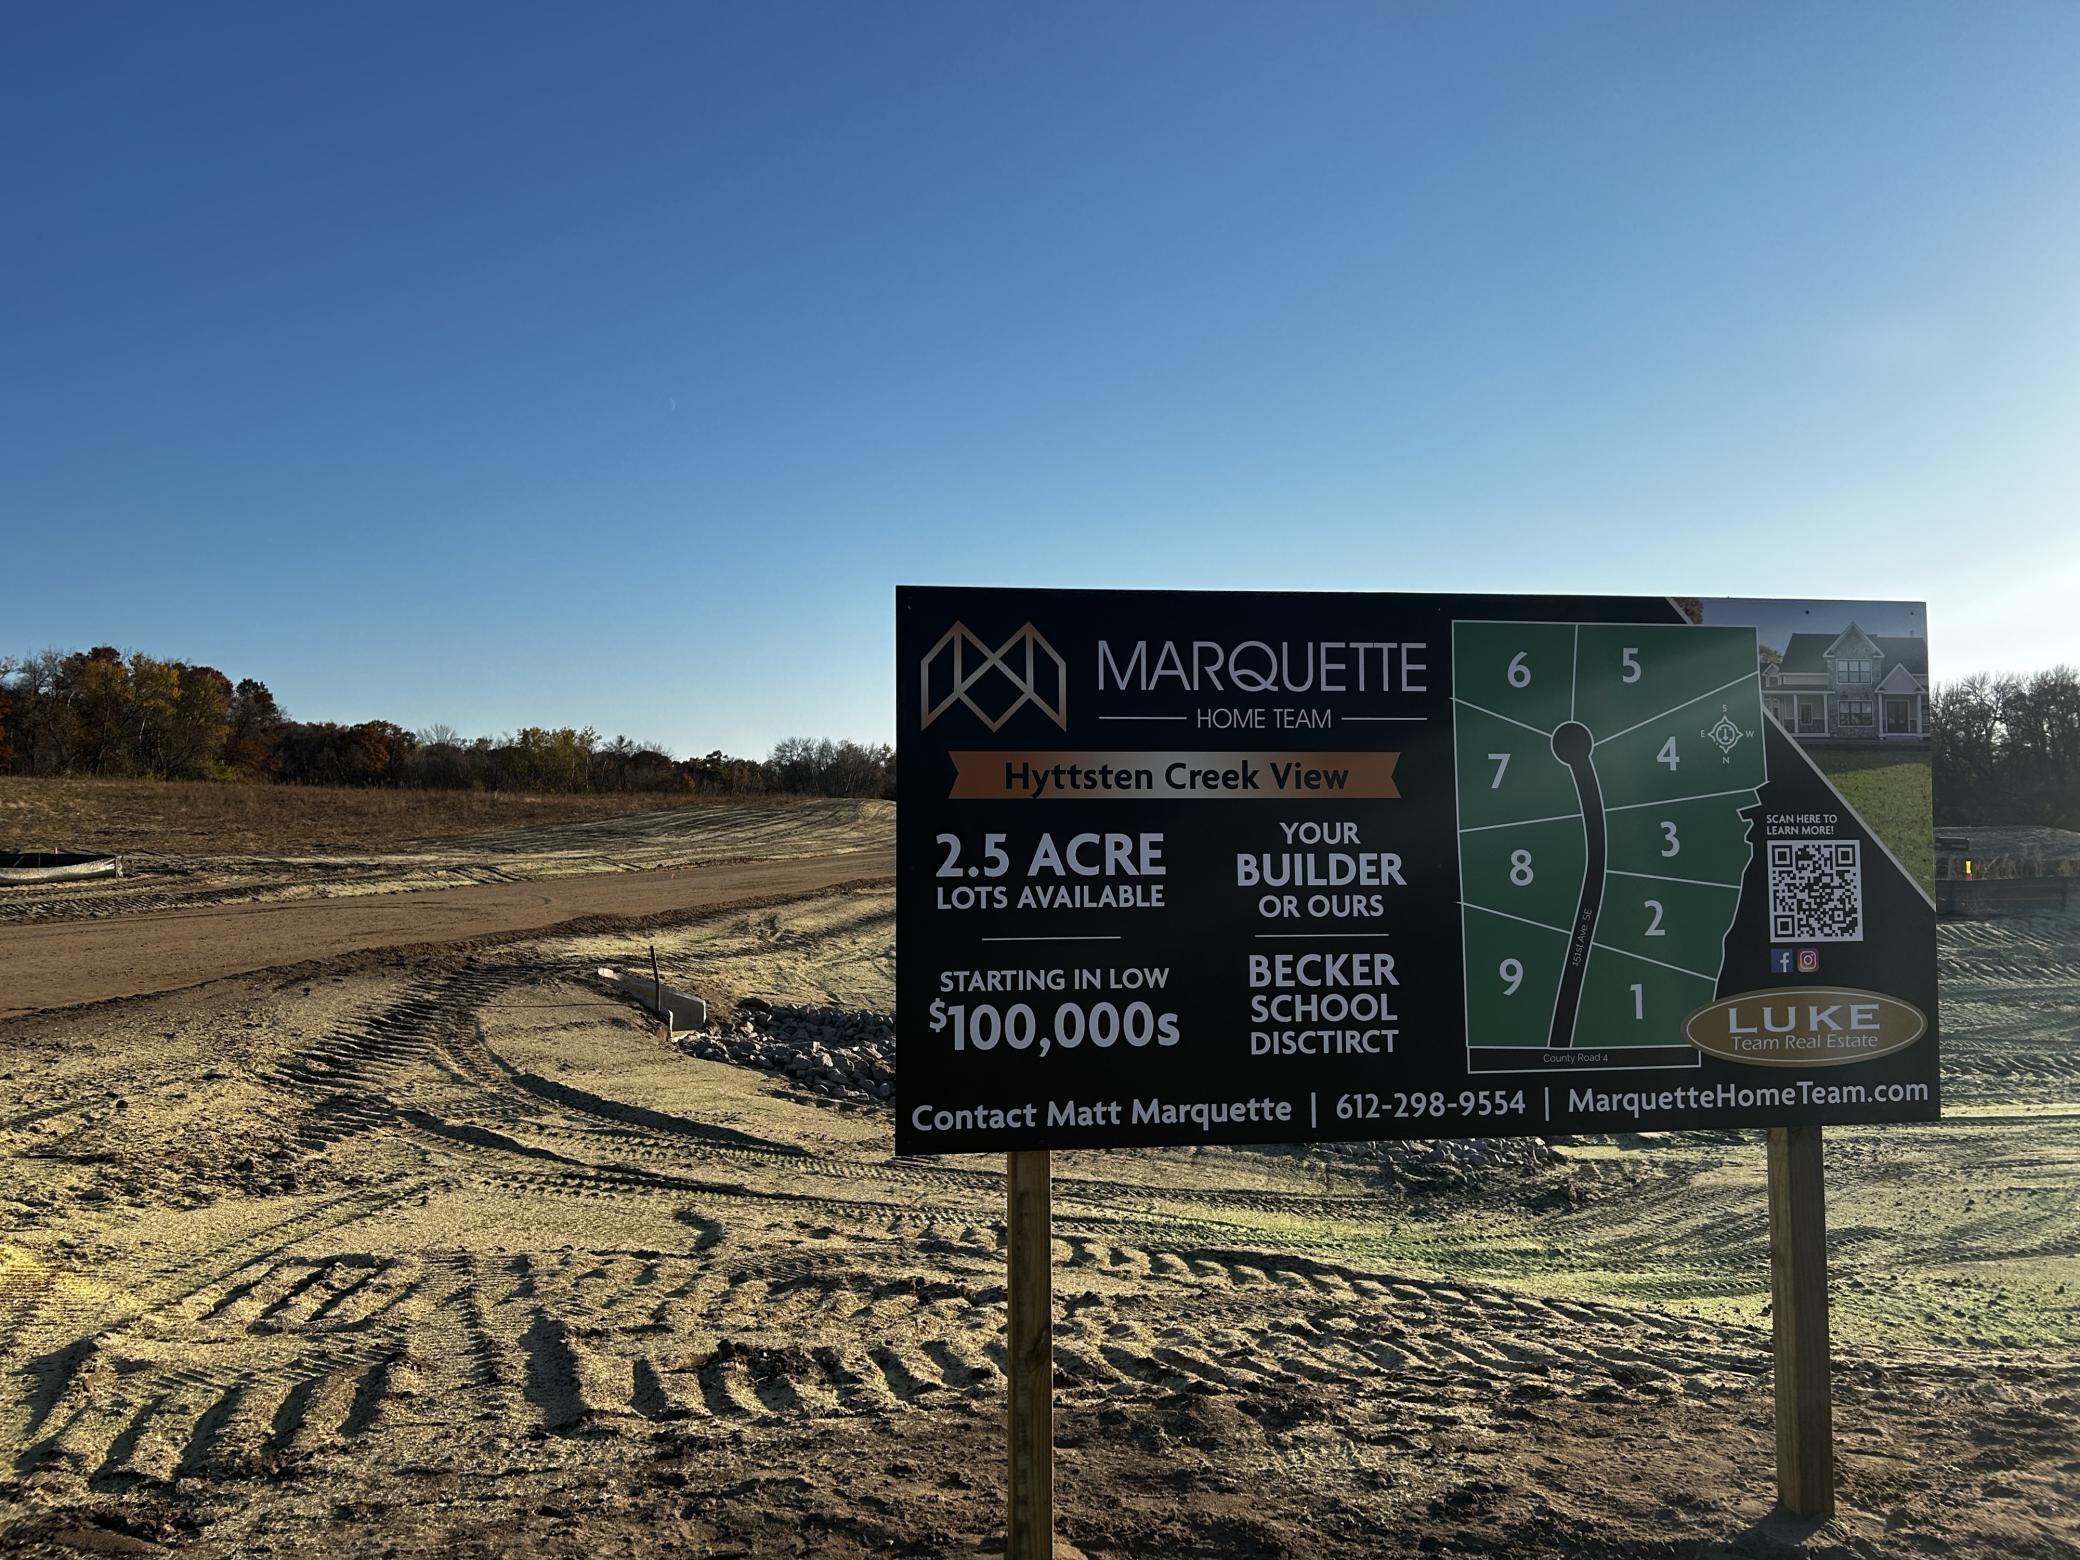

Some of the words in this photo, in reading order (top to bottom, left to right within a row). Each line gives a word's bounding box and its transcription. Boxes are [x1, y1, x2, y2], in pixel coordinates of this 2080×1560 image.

[1098, 640, 1427, 693] MARQUETTE
[1507, 651, 1531, 688] 6
[1622, 647, 1642, 684] 5
[1197, 708, 1265, 729] HOME
[1273, 708, 1332, 729] TEAM
[1722, 704, 1728, 712] S
[1745, 730, 1754, 738] W
[1656, 735, 1680, 771] 4
[1722, 756, 1730, 764] N
[1005, 761, 1153, 798] Hyttsten
[1164, 759, 1261, 790] Creek
[1269, 761, 1350, 790] View
[1487, 752, 1511, 789] 7
[1279, 821, 1361, 845] YOUR
[1766, 814, 1794, 824] SCAN
[1796, 814, 1821, 824] HERE
[1823, 814, 1838, 824] TO
[1766, 825, 1800, 835] LEARN
[1801, 825, 1834, 835] MORE!
[1660, 820, 1680, 858] 3
[935, 832, 1010, 878] 2.5
[1027, 832, 1167, 877] ACRE
[1236, 852, 1408, 887] BUILDER
[1509, 848, 1534, 887] 8
[936, 885, 1008, 910] LOTS
[1017, 884, 1166, 909] AVAILABLE
[1258, 894, 1301, 918] OR
[1307, 894, 1385, 918] OURS
[1582, 907, 1593, 921] SE
[1644, 899, 1666, 936] 2
[1577, 924, 1587, 943] Ave
[1572, 943, 1583, 967] 151st
[939, 968, 1066, 993] STARTING
[1074, 968, 1102, 991] IN
[1110, 967, 1170, 990] LOW
[1248, 953, 1400, 988] BECKER
[1499, 957, 1524, 996] 9
[1250, 993, 1398, 1023] SCHOOL
[1630, 983, 1644, 1020] 1
[929, 997, 1180, 1057] $100,000s
[1728, 1003, 1880, 1034] LUKE
[1251, 1029, 1400, 1056] DISCTIRCT
[1731, 1036, 1779, 1051] Team
[1785, 1034, 1821, 1049] Real
[1827, 1033, 1878, 1049] Estate
[1543, 1053, 1576, 1064] County
[1577, 1052, 1601, 1062] Road
[1602, 1053, 1608, 1063] 4
[911, 1103, 1037, 1132] Contact
[1046, 1099, 1122, 1127] Matt
[1132, 1097, 1292, 1132] Marquette
[1336, 1090, 1526, 1120] 612-298-9554
[1568, 1081, 1929, 1119] MarquetteHomeTeam.com
